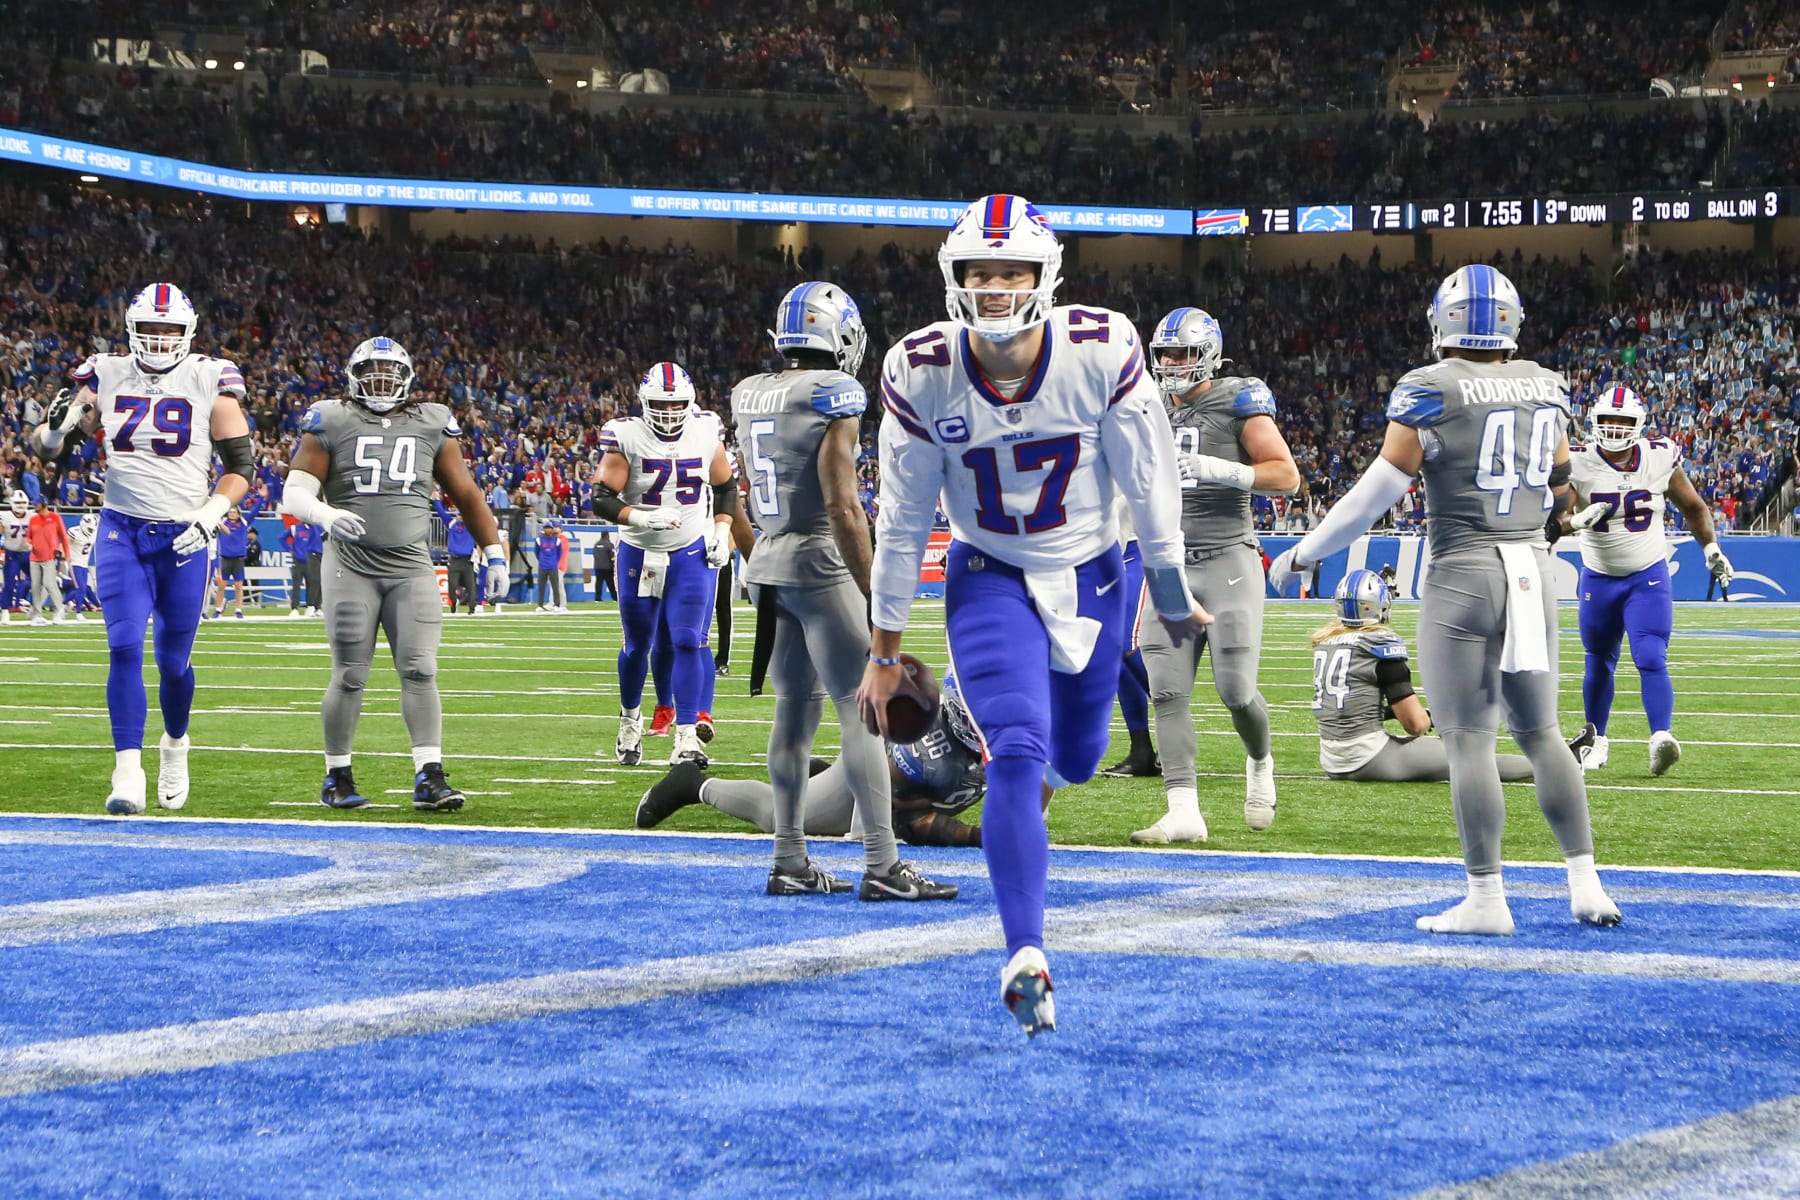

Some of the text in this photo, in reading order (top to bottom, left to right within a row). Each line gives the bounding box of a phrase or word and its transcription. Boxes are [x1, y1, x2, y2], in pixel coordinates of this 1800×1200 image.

[0, 135, 32, 155] LIONS.
[42, 143, 61, 160] WE
[63, 147, 86, 164] ARE
[87, 151, 131, 172] HENRY
[179, 167, 217, 187] OFFICIAL
[218, 175, 288, 194] HEALTHCARE
[291, 181, 363, 197] PROVIDER
[365, 185, 385, 198] OF
[388, 185, 415, 199] THE
[417, 187, 477, 201] DETROIT
[479, 189, 526, 205] LIONS.
[529, 191, 558, 206] AND
[561, 192, 594, 207] YOU.
[630, 194, 654, 209] WE
[656, 196, 700, 211] OFFER
[702, 198, 730, 212] YOU
[733, 199, 759, 213] THE
[761, 200, 798, 214] SAME
[801, 202, 837, 216] ELITE
[838, 203, 873, 217] CARE
[876, 205, 896, 218] WE
[898, 206, 928, 220] GIVE
[931, 208, 949, 220] TO
[1049, 211, 1164, 228] WE ARE HENRY
[1262, 208, 1273, 232] 7
[1370, 205, 1382, 229] 7
[1421, 208, 1439, 223] QTR
[1443, 203, 1456, 228] 2
[1481, 201, 1522, 226] 7:55
[1570, 204, 1606, 223] DOWN
[1632, 196, 1645, 222] 2
[1655, 202, 1671, 220] TO
[1673, 202, 1690, 219] GO
[1708, 200, 1737, 218] BALL
[1739, 199, 1757, 217] ON
[1764, 191, 1778, 217] 3
[1069, 309, 1110, 343] 17
[1459, 337, 1504, 348] DETROIT
[904, 330, 951, 368] 17
[737, 386, 791, 414] ELLIOTT
[829, 390, 865, 408] LIONS
[1458, 377, 1560, 406] RODRIGUEZ
[111, 395, 193, 457] 79
[1002, 432, 1034, 442] BILLS
[352, 436, 417, 496] 54
[750, 418, 780, 516] 5
[1474, 404, 1558, 516] 44
[642, 457, 702, 506] 75
[961, 433, 1080, 535] 17
[1590, 489, 1653, 532] 76
[921, 729, 952, 760] 96
